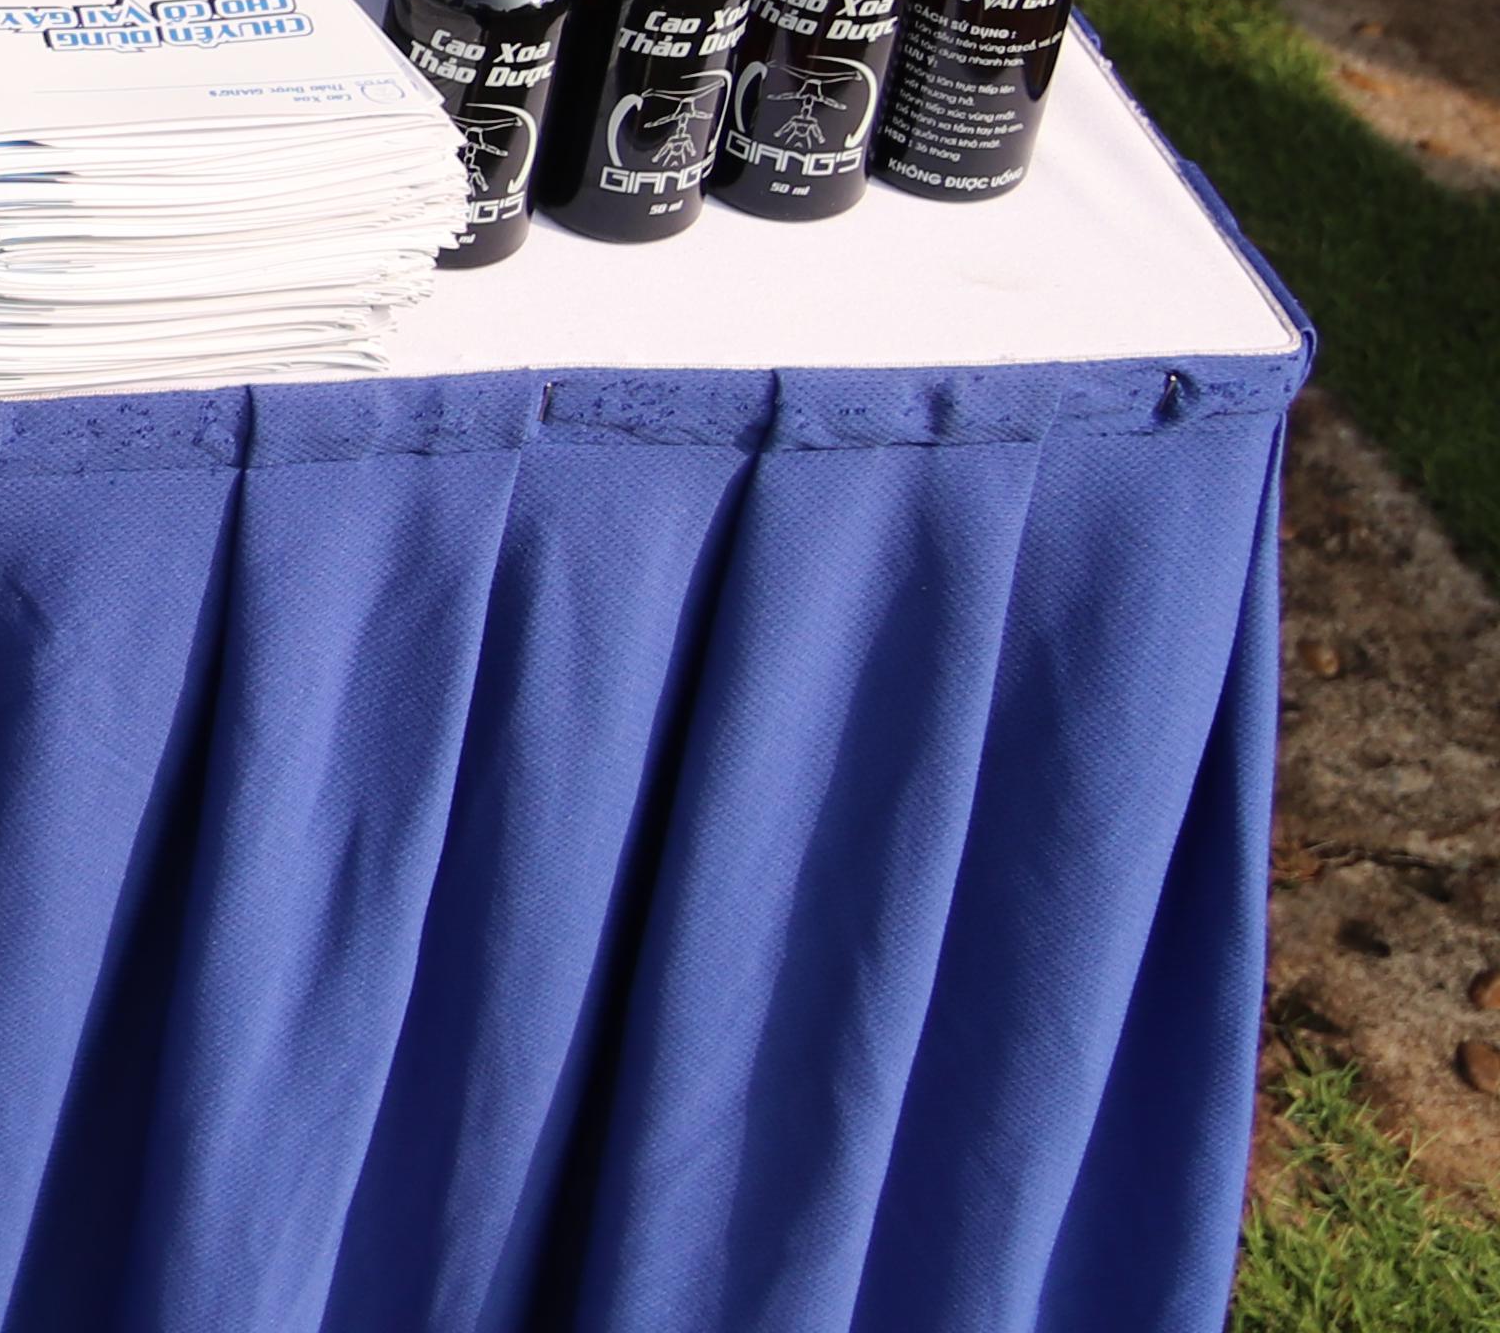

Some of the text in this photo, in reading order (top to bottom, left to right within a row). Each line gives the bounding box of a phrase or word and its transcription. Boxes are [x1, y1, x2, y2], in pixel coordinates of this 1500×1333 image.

[85, 4, 151, 27] VAI
[163, 3, 206, 26] CỔ
[645, 0, 749, 34] Cao Xoa
[826, 16, 898, 42] Dược
[914, 2, 948, 27] CÁCH
[55, 17, 305, 51] CHUYÊN DÙNG
[431, 28, 551, 64] Cao Xoa
[617, 27, 693, 58] Thảo
[409, 40, 477, 86] Thảo
[726, 129, 863, 176] GIANG'S
[770, 182, 811, 197] 50 ml
[887, 157, 1024, 191] KHÔNG ĐƯỢC UỐNG
[648, 200, 683, 215] 50 ml
